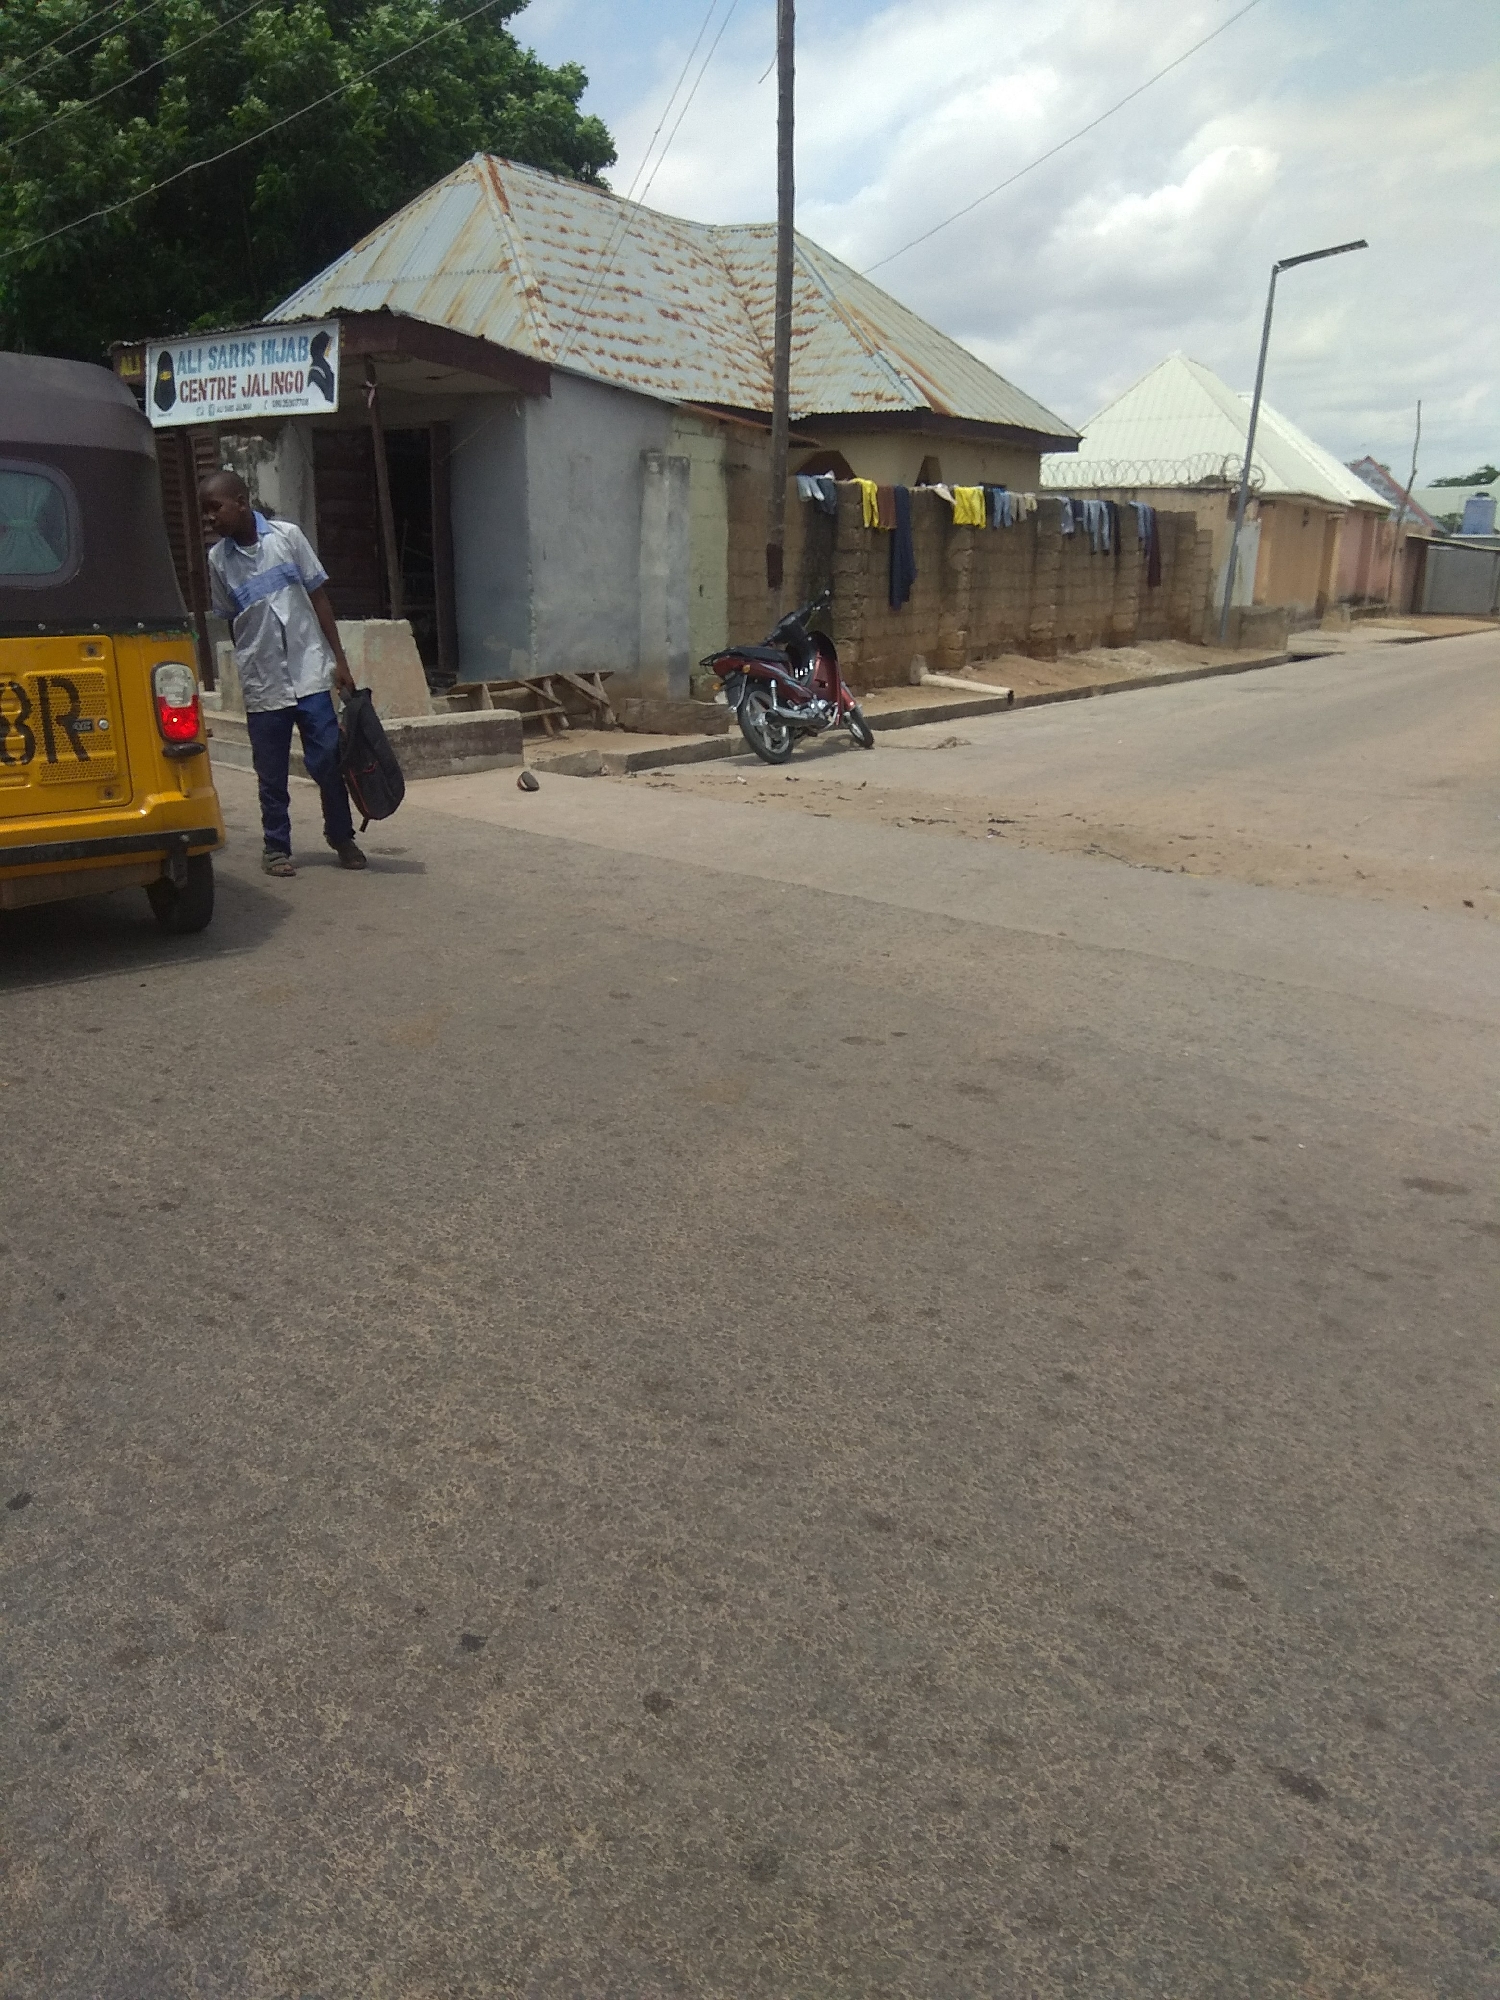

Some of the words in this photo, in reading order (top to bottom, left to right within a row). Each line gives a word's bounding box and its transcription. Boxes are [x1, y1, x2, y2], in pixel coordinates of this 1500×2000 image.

[177, 348, 202, 376] ALI
[208, 341, 255, 371] SARIS
[261, 335, 309, 366] HIJAB
[179, 376, 237, 404] CENTRE
[241, 369, 304, 398] JALINGO
